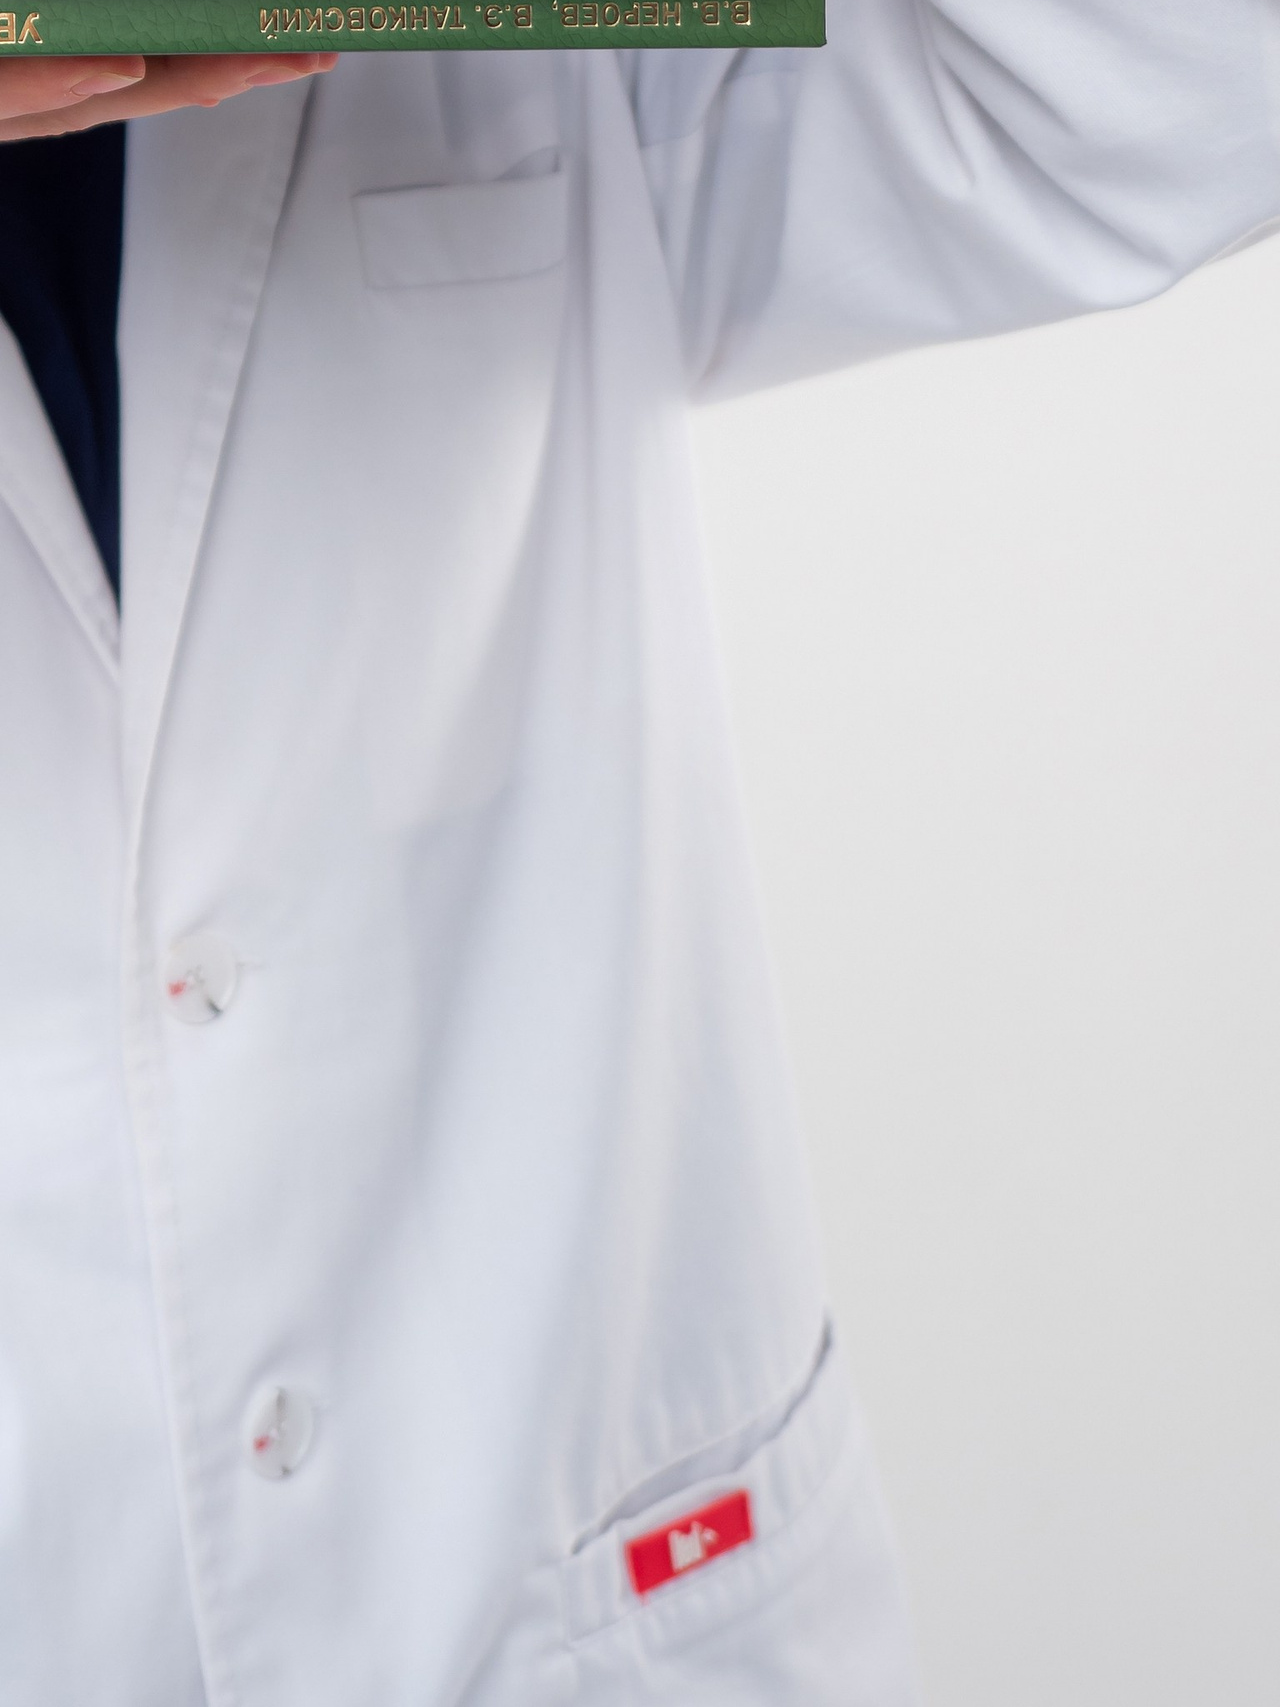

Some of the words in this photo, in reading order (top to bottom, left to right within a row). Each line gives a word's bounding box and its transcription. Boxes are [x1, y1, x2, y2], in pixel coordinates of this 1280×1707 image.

[260, 6, 465, 40] ТАНКОВСКИЙ
[475, 5, 533, 29] В.Э.
[552, 1, 681, 27] НЕРОЕВ,
[693, 0, 751, 26] В.В.
